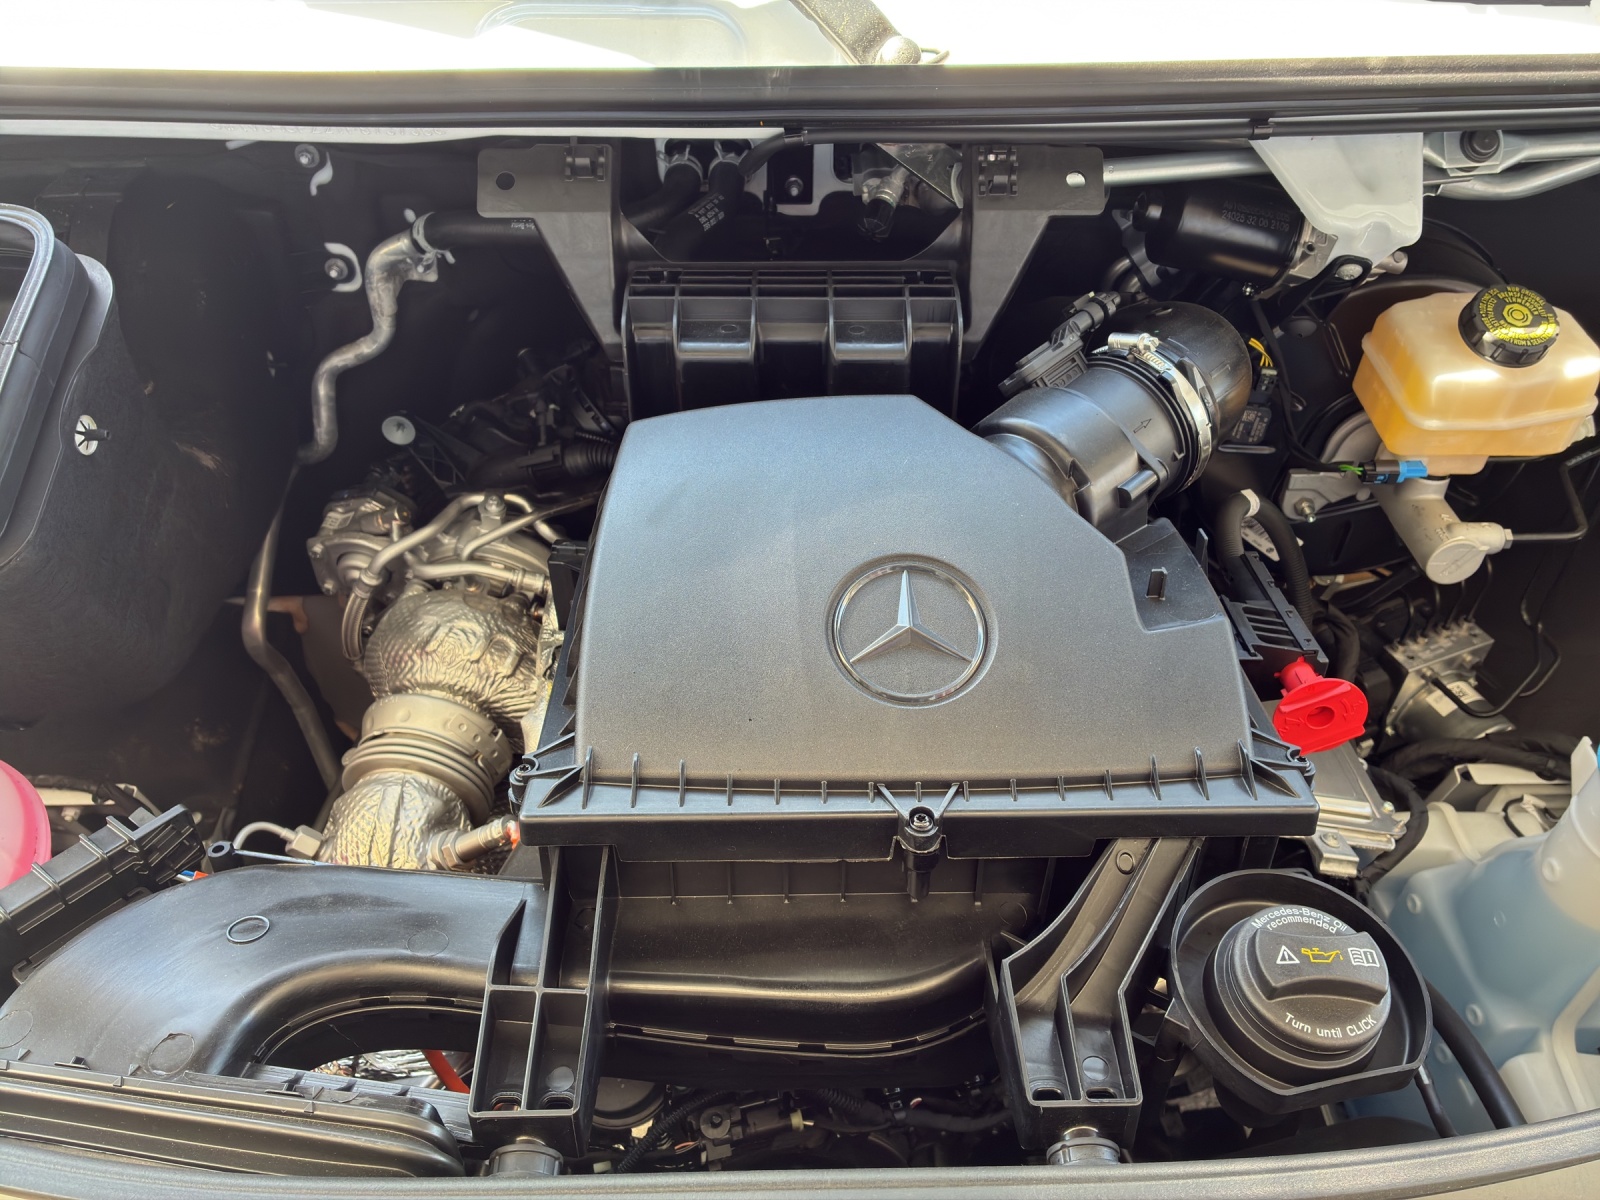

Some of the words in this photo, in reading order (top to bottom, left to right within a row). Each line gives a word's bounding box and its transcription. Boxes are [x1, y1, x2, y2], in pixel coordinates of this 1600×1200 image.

[1251, 907, 1330, 929] Mercedes-Benz
[1333, 919, 1347, 932] Oil
[1266, 915, 1337, 934] recommended
[1285, 1012, 1312, 1033] Turn
[1316, 1027, 1342, 1038] until
[1346, 1014, 1377, 1037] CLICK
